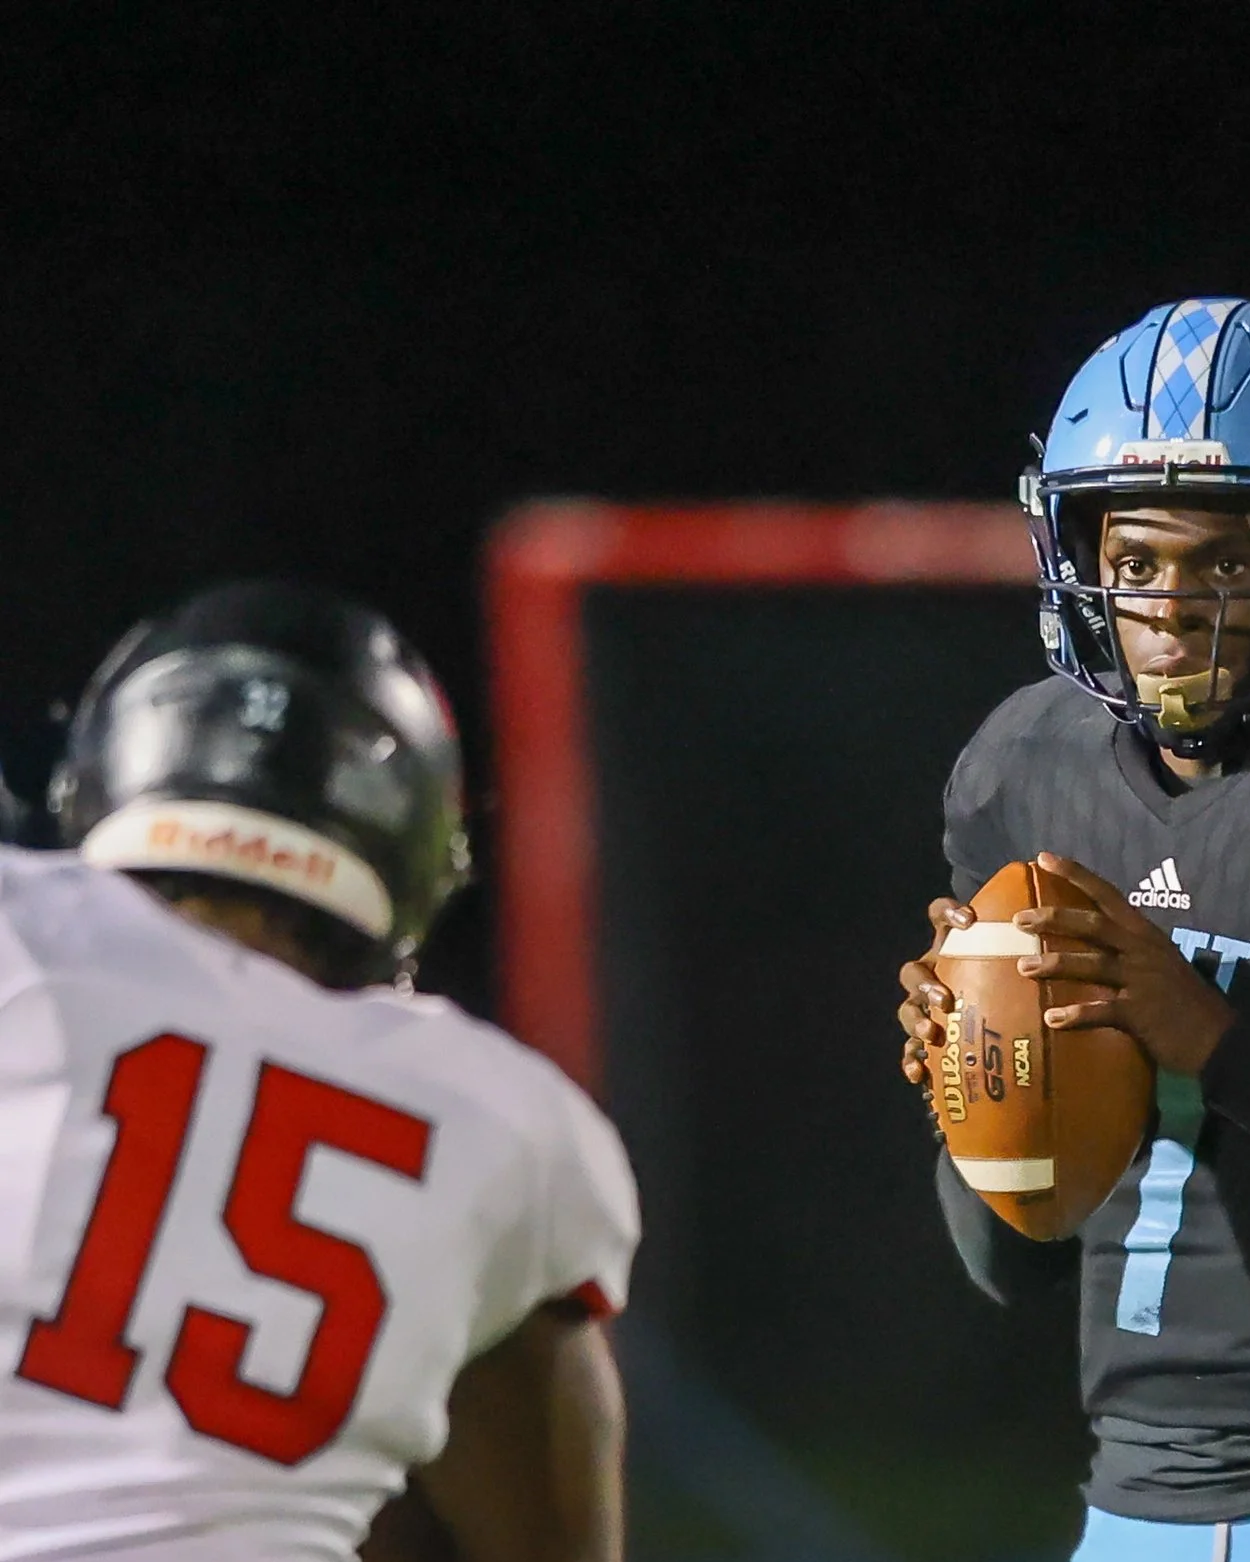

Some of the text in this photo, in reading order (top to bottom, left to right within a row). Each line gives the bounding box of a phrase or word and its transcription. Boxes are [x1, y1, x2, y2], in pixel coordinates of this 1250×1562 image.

[1128, 887, 1191, 910] adidas
[941, 997, 968, 1123] Wilson
[1013, 1037, 1031, 1087] NCAA
[16, 1032, 437, 1468] 15
